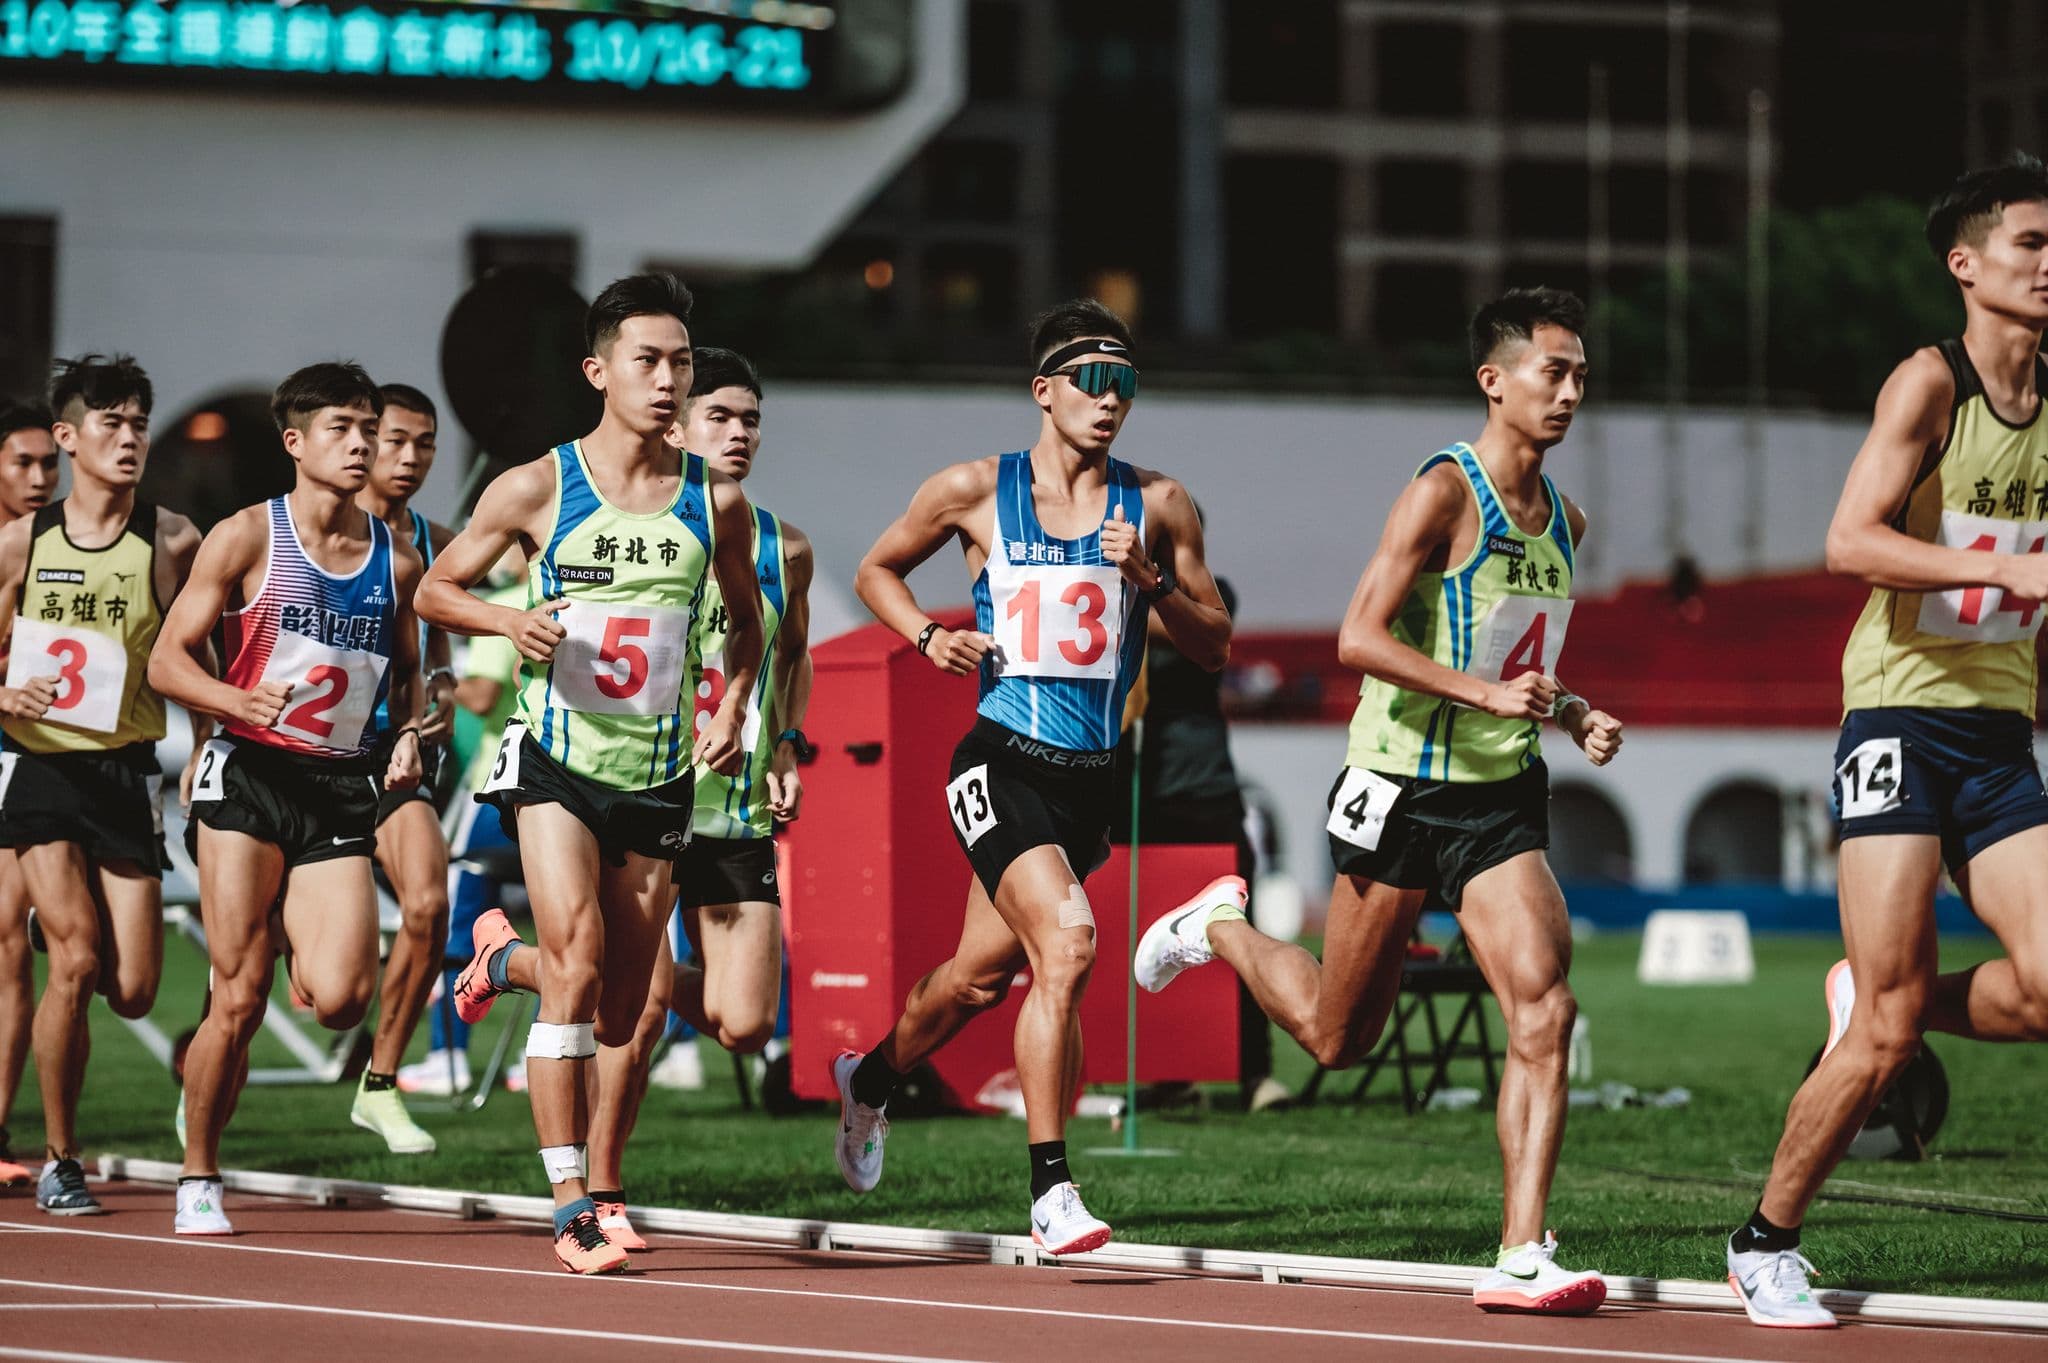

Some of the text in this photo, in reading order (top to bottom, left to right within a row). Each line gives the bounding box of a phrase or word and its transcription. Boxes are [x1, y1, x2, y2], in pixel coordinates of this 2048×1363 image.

[592, 534, 680, 567] 新北市
[1009, 541, 1065, 563] 臺北市
[570, 570, 612, 580] RACE ON
[1506, 556, 1560, 594] 新北市
[40, 591, 128, 627] 高雄市
[1007, 580, 1108, 666] 13
[594, 616, 652, 699] 5
[1500, 611, 1549, 682] 4
[46, 638, 88, 710] 3
[284, 664, 349, 739] 2
[198, 750, 215, 789] 2
[493, 738, 511, 781] 5
[1006, 734, 1112, 769] NIKE PRO
[1843, 752, 1896, 803] 14
[954, 778, 989, 832] 13
[1343, 787, 1370, 831] 4
